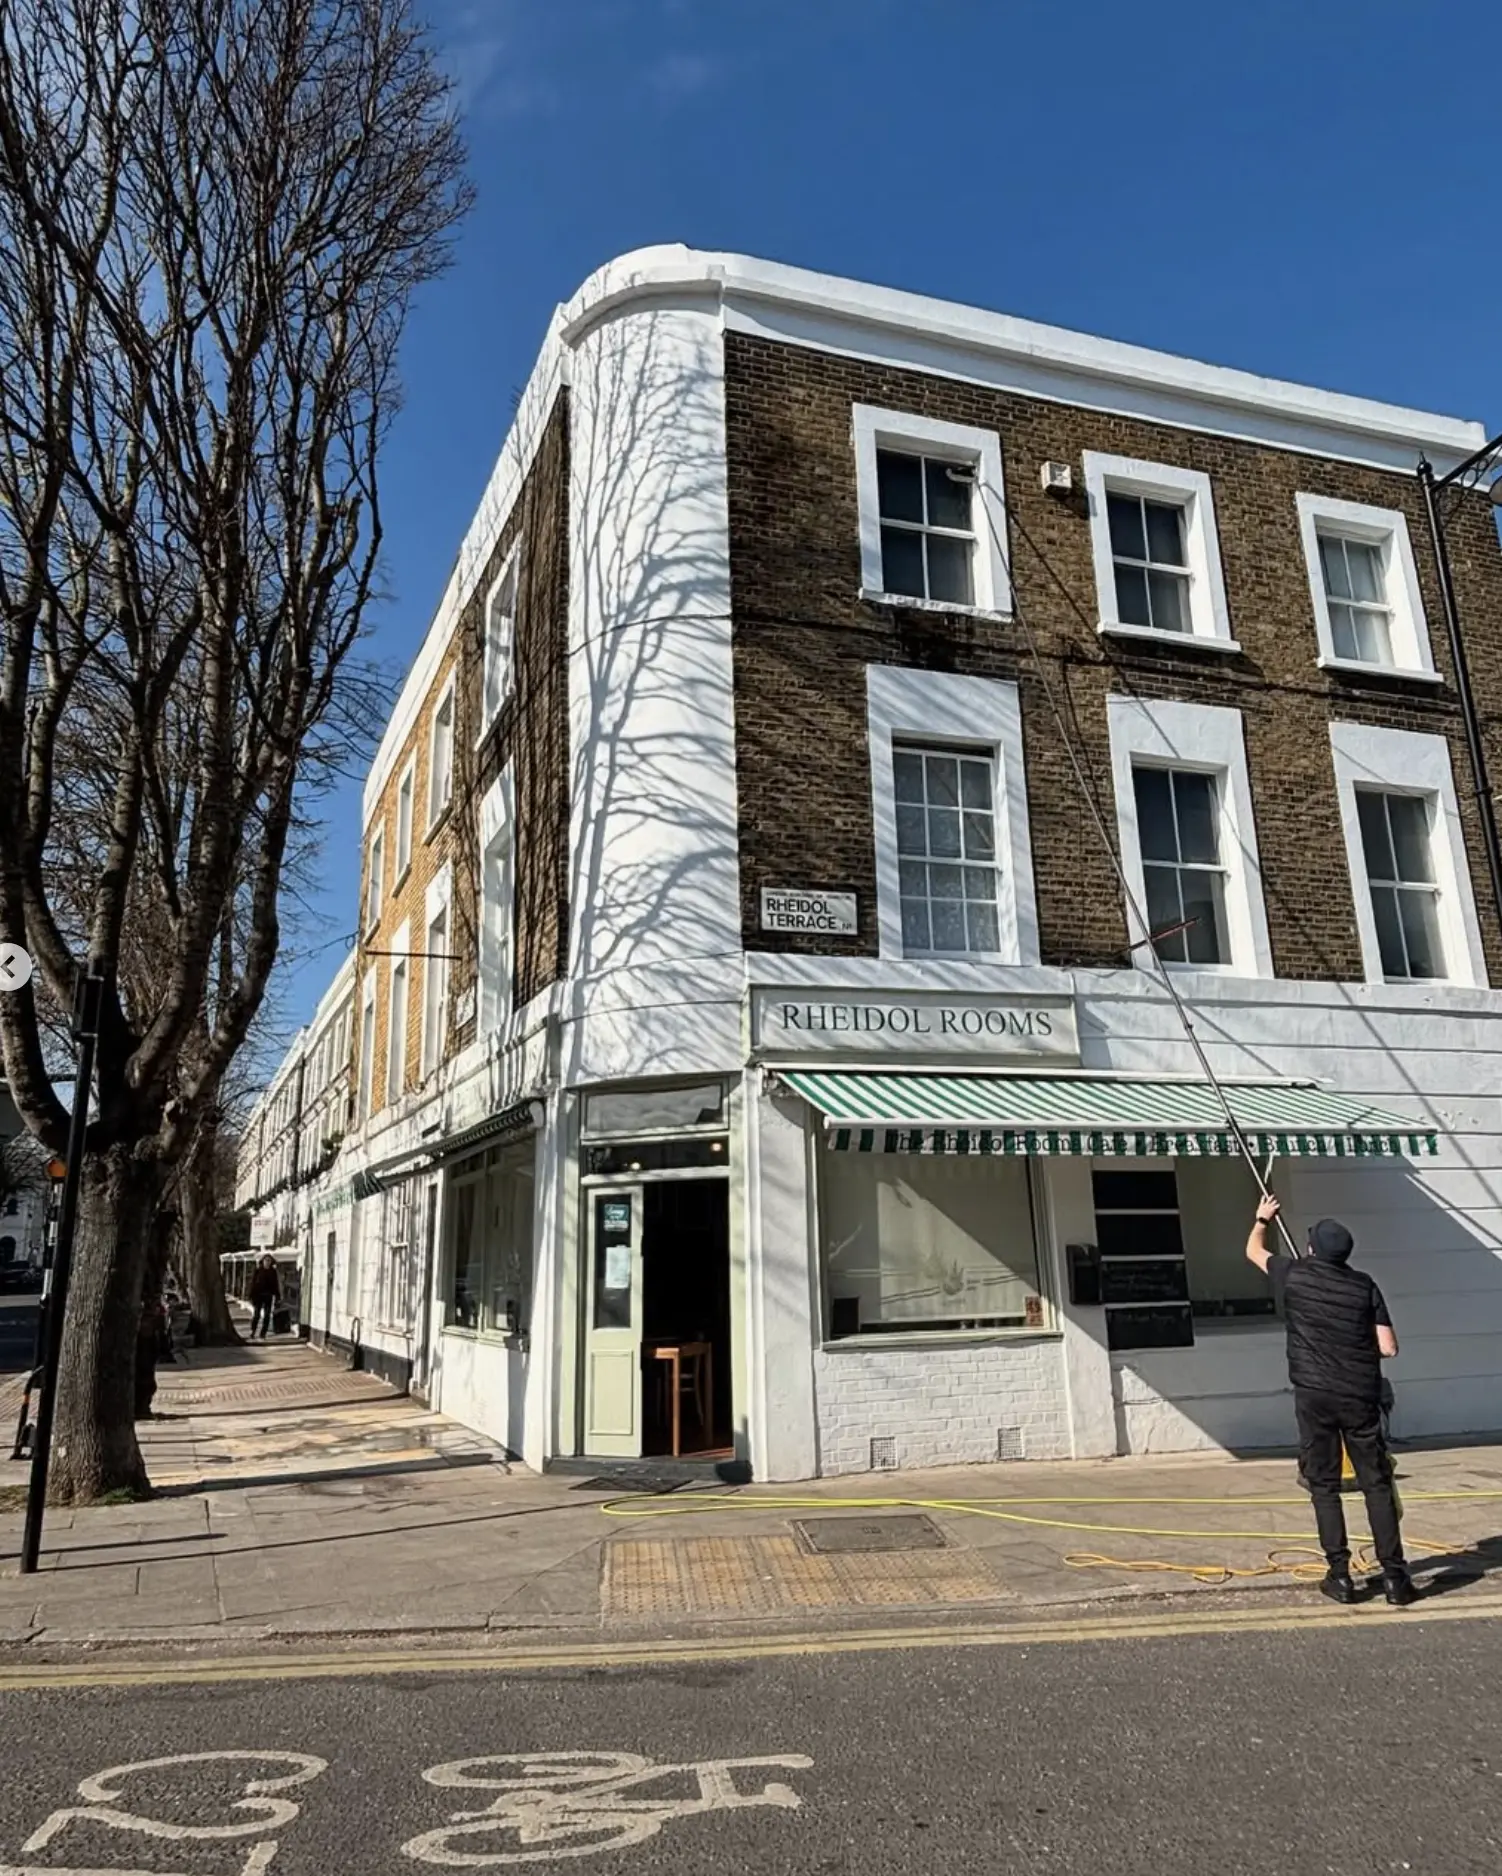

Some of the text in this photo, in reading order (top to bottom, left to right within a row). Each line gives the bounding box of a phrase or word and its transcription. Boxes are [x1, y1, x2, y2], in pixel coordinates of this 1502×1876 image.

[767, 898, 832, 914] RHEIDOL
[767, 913, 837, 929] TERRACE
[782, 1004, 1053, 1036] RHEIDOL ROOMS
